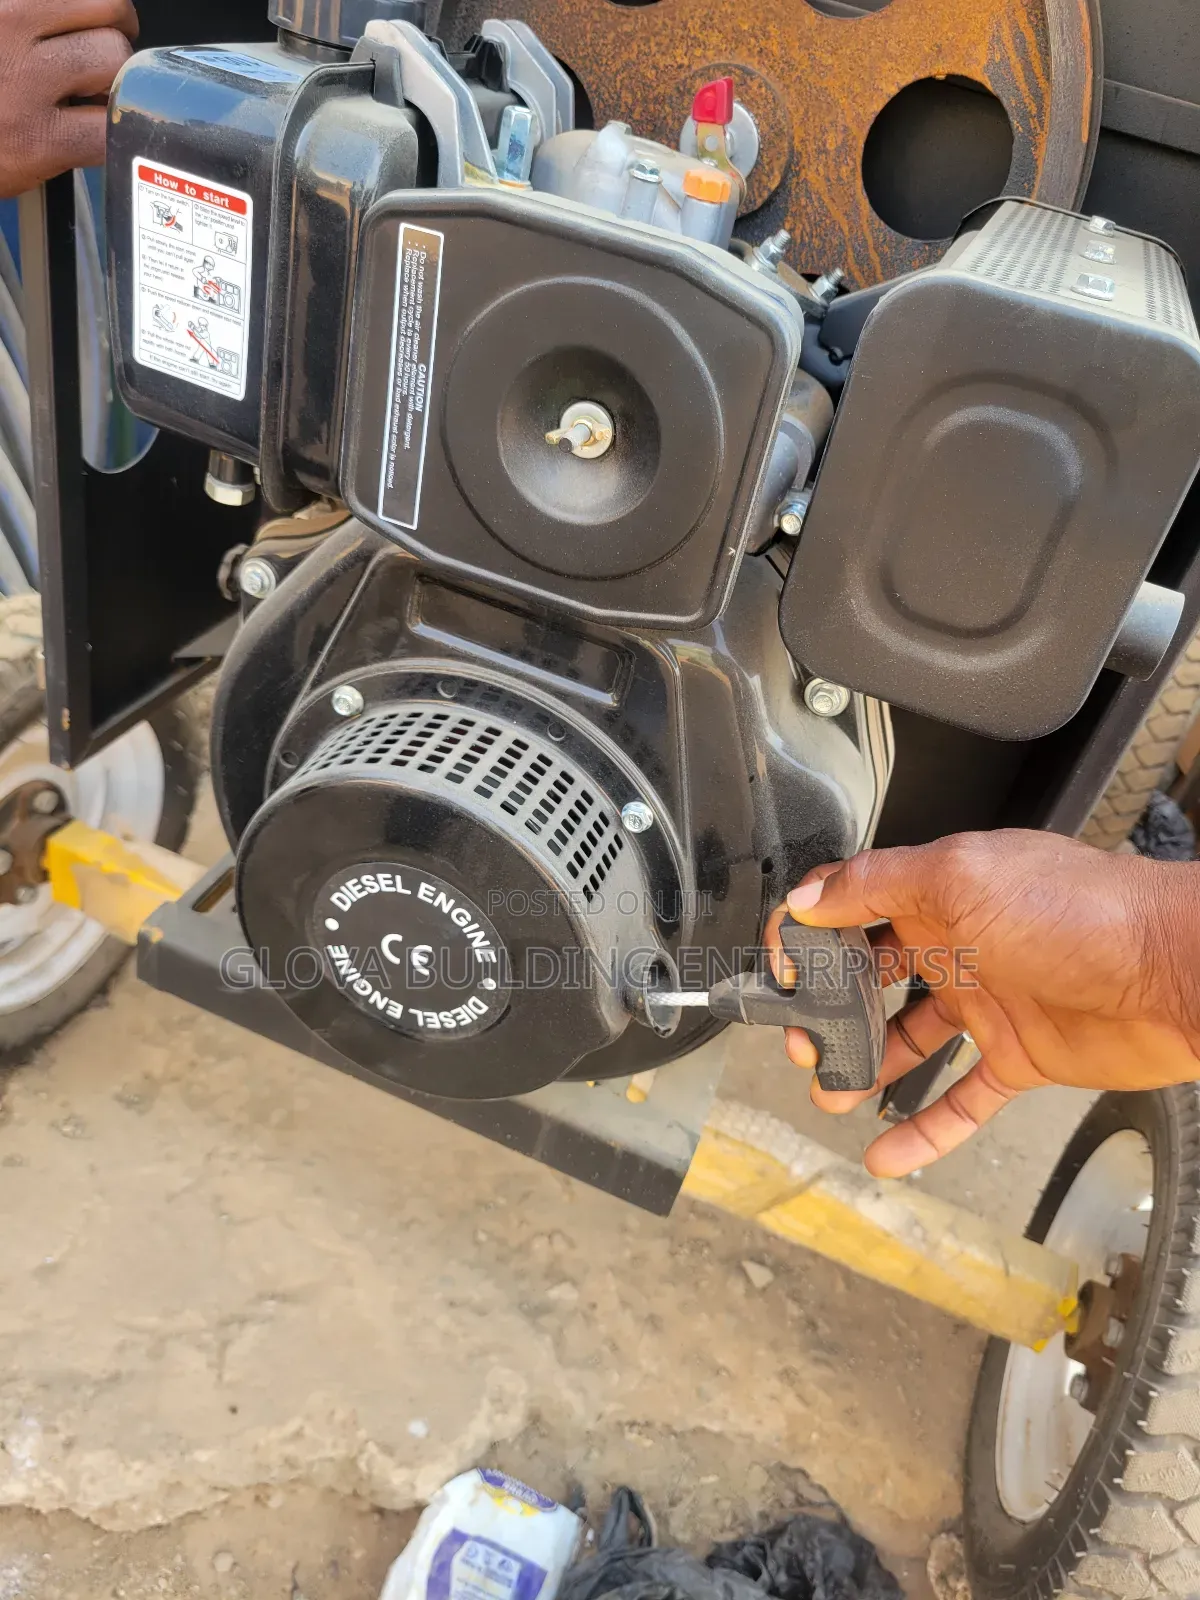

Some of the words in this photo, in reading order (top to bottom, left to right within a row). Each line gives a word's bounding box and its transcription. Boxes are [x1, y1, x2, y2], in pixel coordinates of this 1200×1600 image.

[154, 173, 178, 190] How
[185, 183, 196, 196] to
[203, 190, 229, 208] start
[403, 247, 412, 283] Replace
[420, 251, 427, 265] Do
[409, 249, 420, 305] Replacement
[399, 308, 407, 335] output
[407, 306, 415, 327] cycle
[404, 337, 412, 361] every
[412, 332, 420, 363] cleaner
[409, 363, 418, 395] element
[414, 363, 427, 412] CAUTION
[330, 873, 412, 912] DIESEL
[417, 882, 497, 963] ENGINE
[327, 945, 404, 1019] ENGINE
[408, 995, 489, 1029] DIESEL
